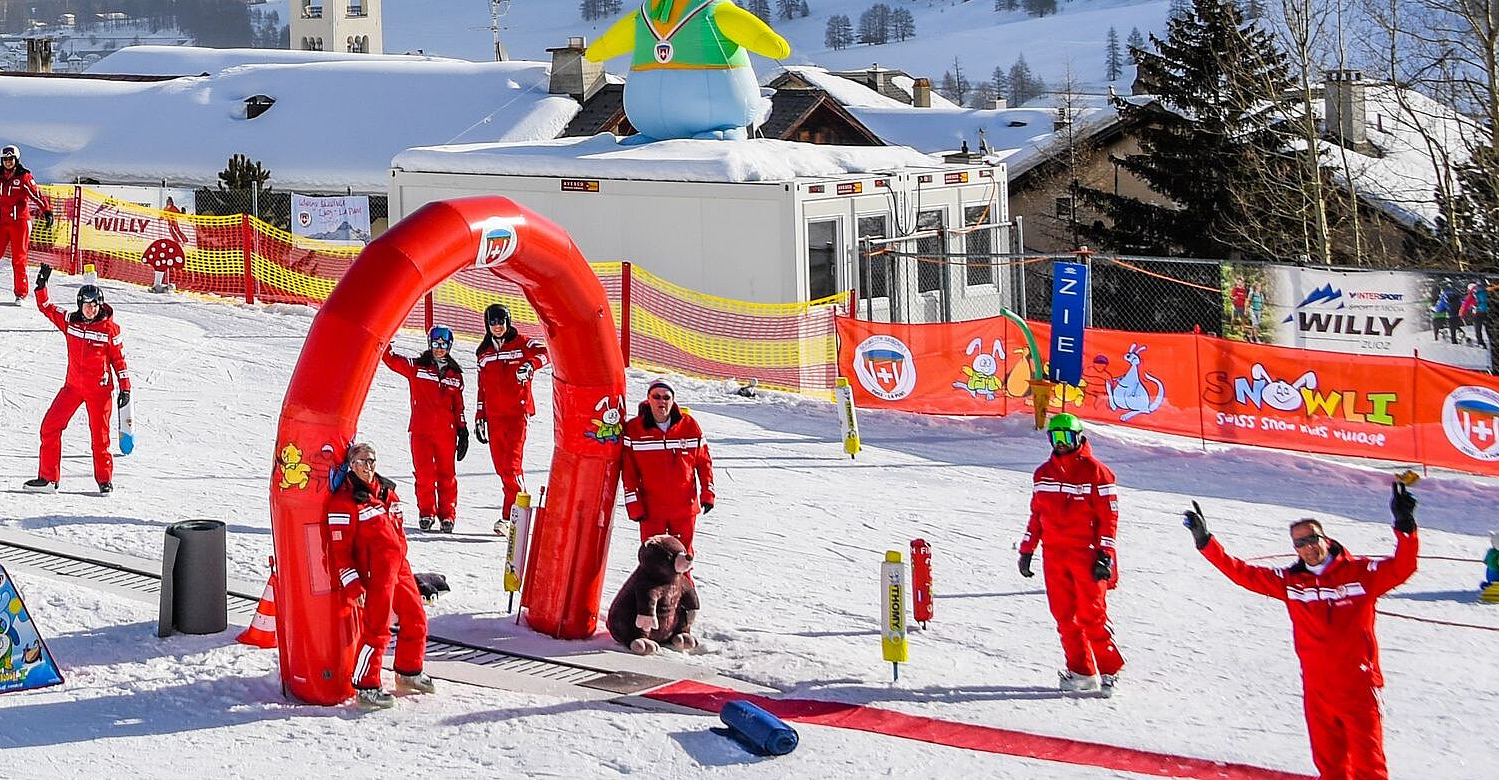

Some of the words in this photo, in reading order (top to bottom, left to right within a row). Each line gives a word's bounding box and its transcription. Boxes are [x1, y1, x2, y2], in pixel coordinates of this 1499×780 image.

[94, 217, 150, 233] WILLY
[1298, 311, 1403, 337] WILLY
[1361, 340, 1391, 350] ZUOZ
[1203, 364, 1398, 426] SNOWLI
[890, 584, 901, 630] THOMY
